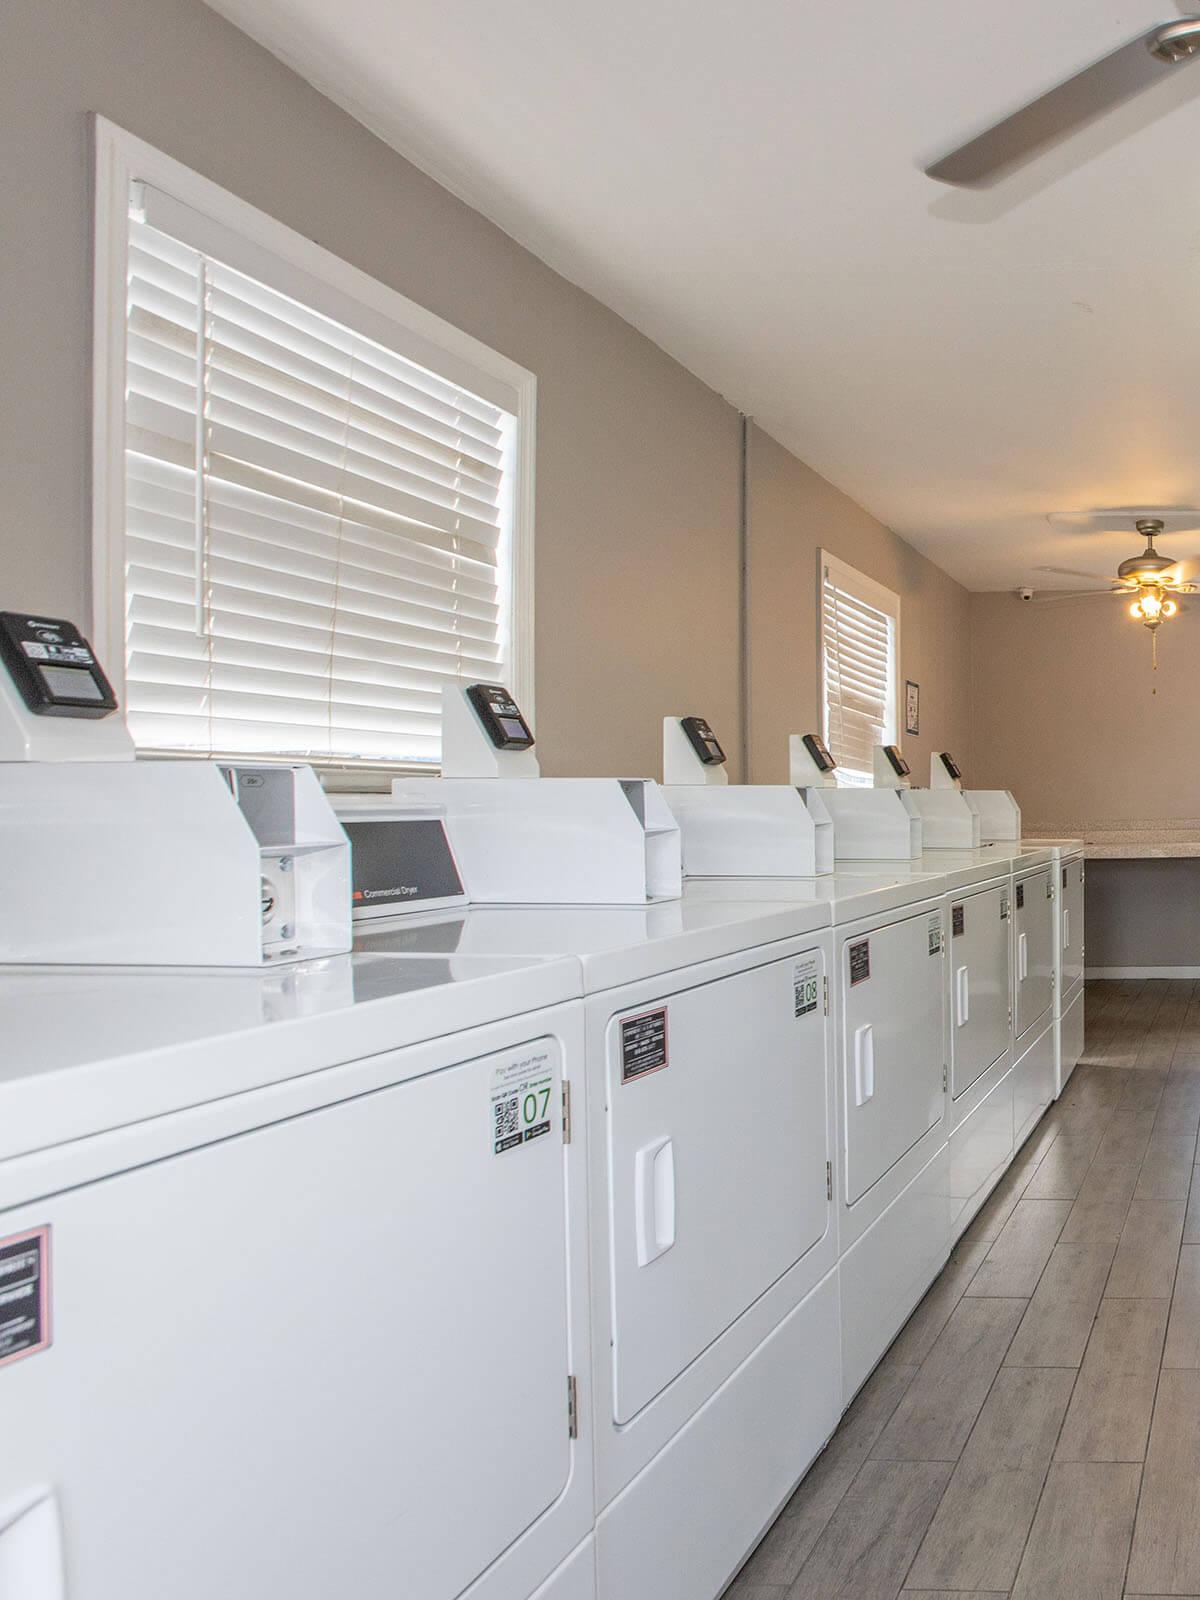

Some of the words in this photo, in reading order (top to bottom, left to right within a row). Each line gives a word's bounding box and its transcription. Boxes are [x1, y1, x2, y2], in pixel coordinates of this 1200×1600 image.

[364, 889, 401, 898] Commercial
[401, 886, 417, 896] Dryer
[805, 981, 817, 1002] 08
[532, 1054, 548, 1063] Phone
[523, 1088, 551, 1124] 07
